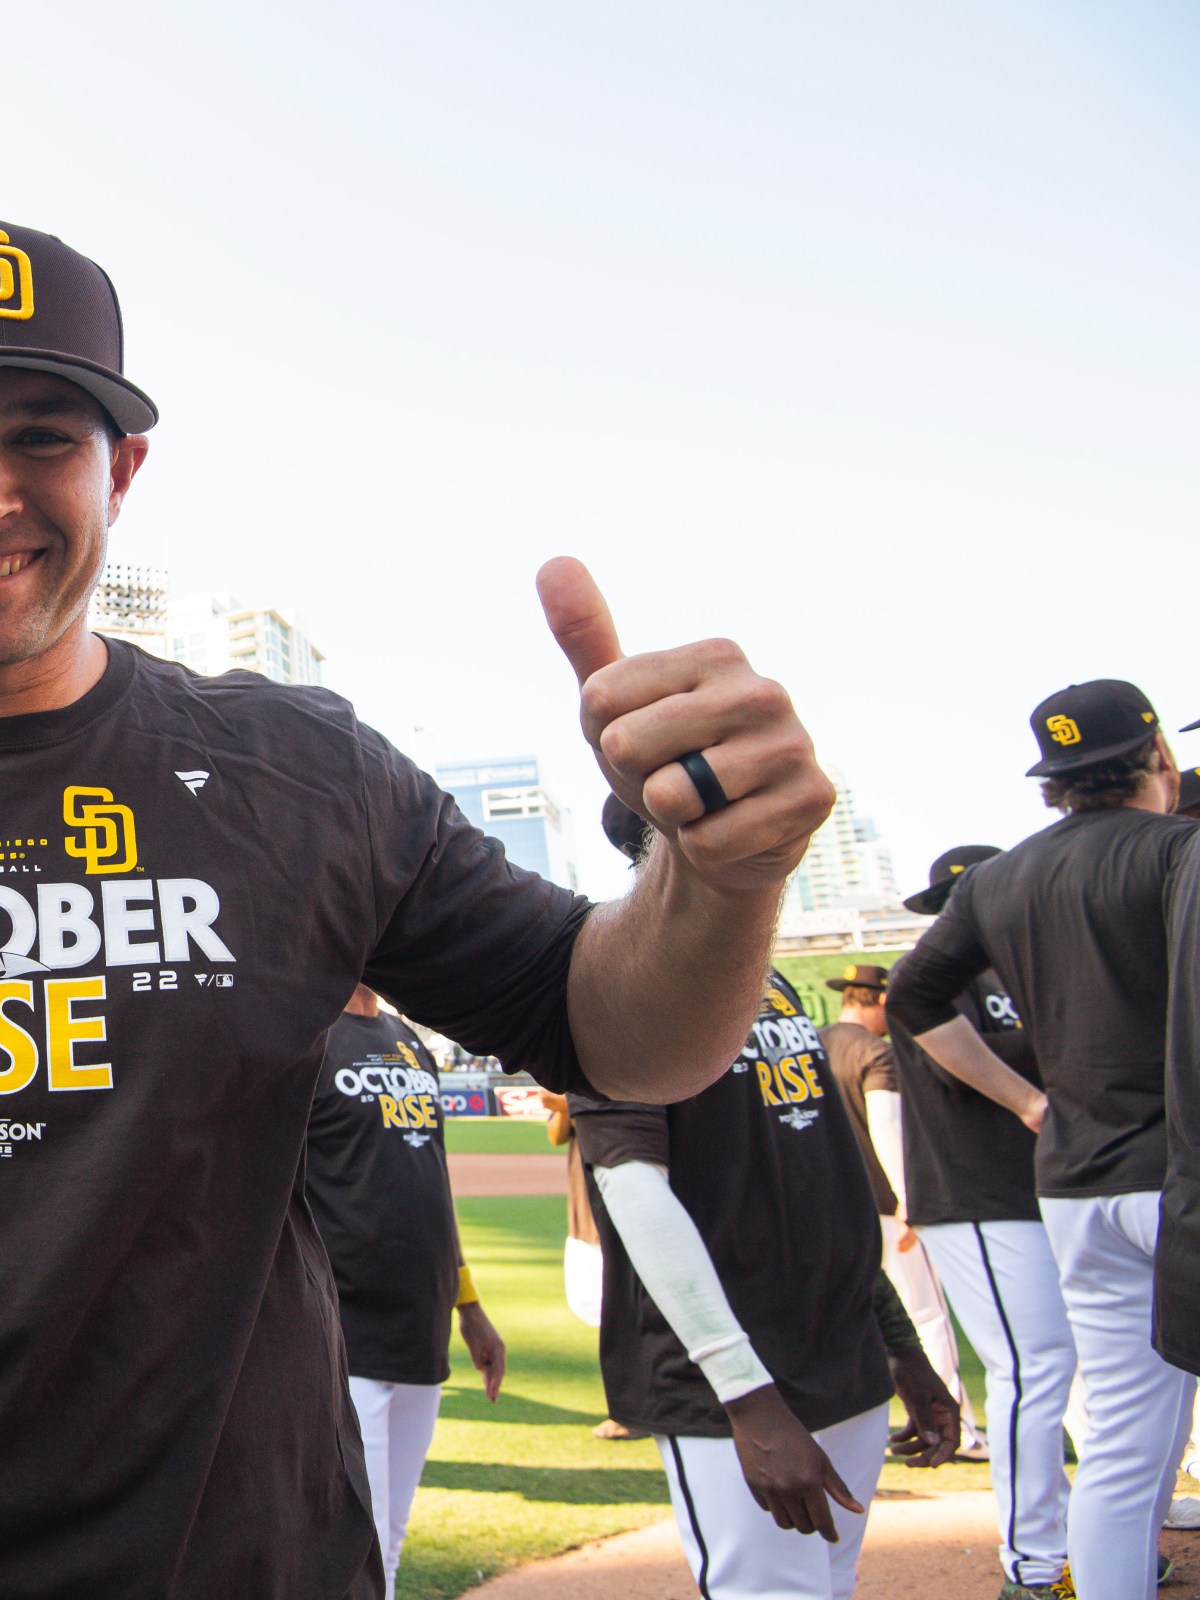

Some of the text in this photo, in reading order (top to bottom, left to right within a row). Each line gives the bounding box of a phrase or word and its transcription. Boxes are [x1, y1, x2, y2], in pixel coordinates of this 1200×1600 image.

[132, 970, 178, 991] 22
[755, 1053, 825, 1107] RISE
[378, 1093, 438, 1128] RISE
